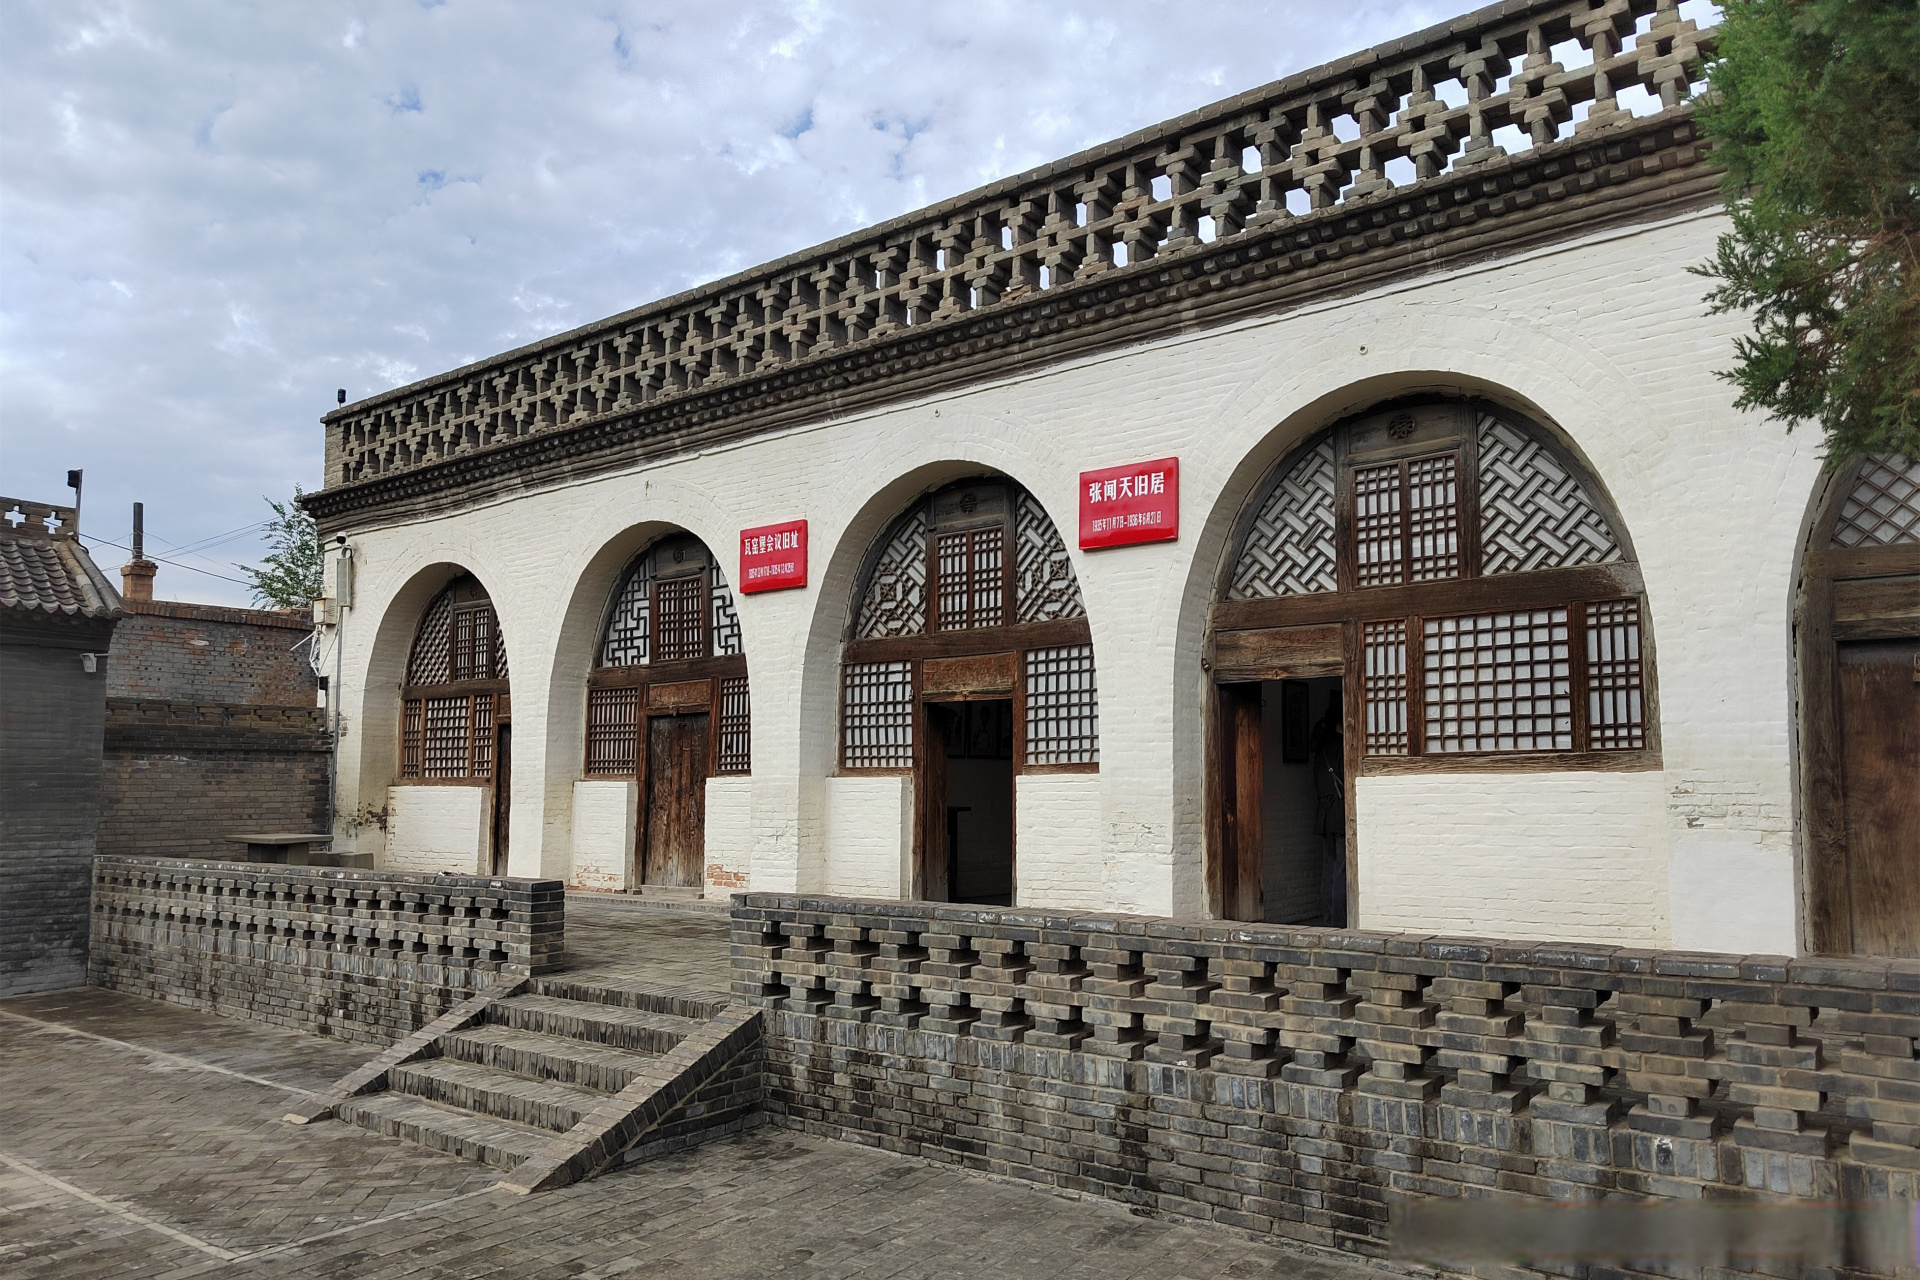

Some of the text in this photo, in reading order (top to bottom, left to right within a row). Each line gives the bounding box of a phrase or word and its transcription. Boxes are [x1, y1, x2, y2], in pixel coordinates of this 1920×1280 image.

[1089, 472, 1165, 503] 张闻天旧居
[744, 530, 799, 555] 瓦窑堡会议旧址
